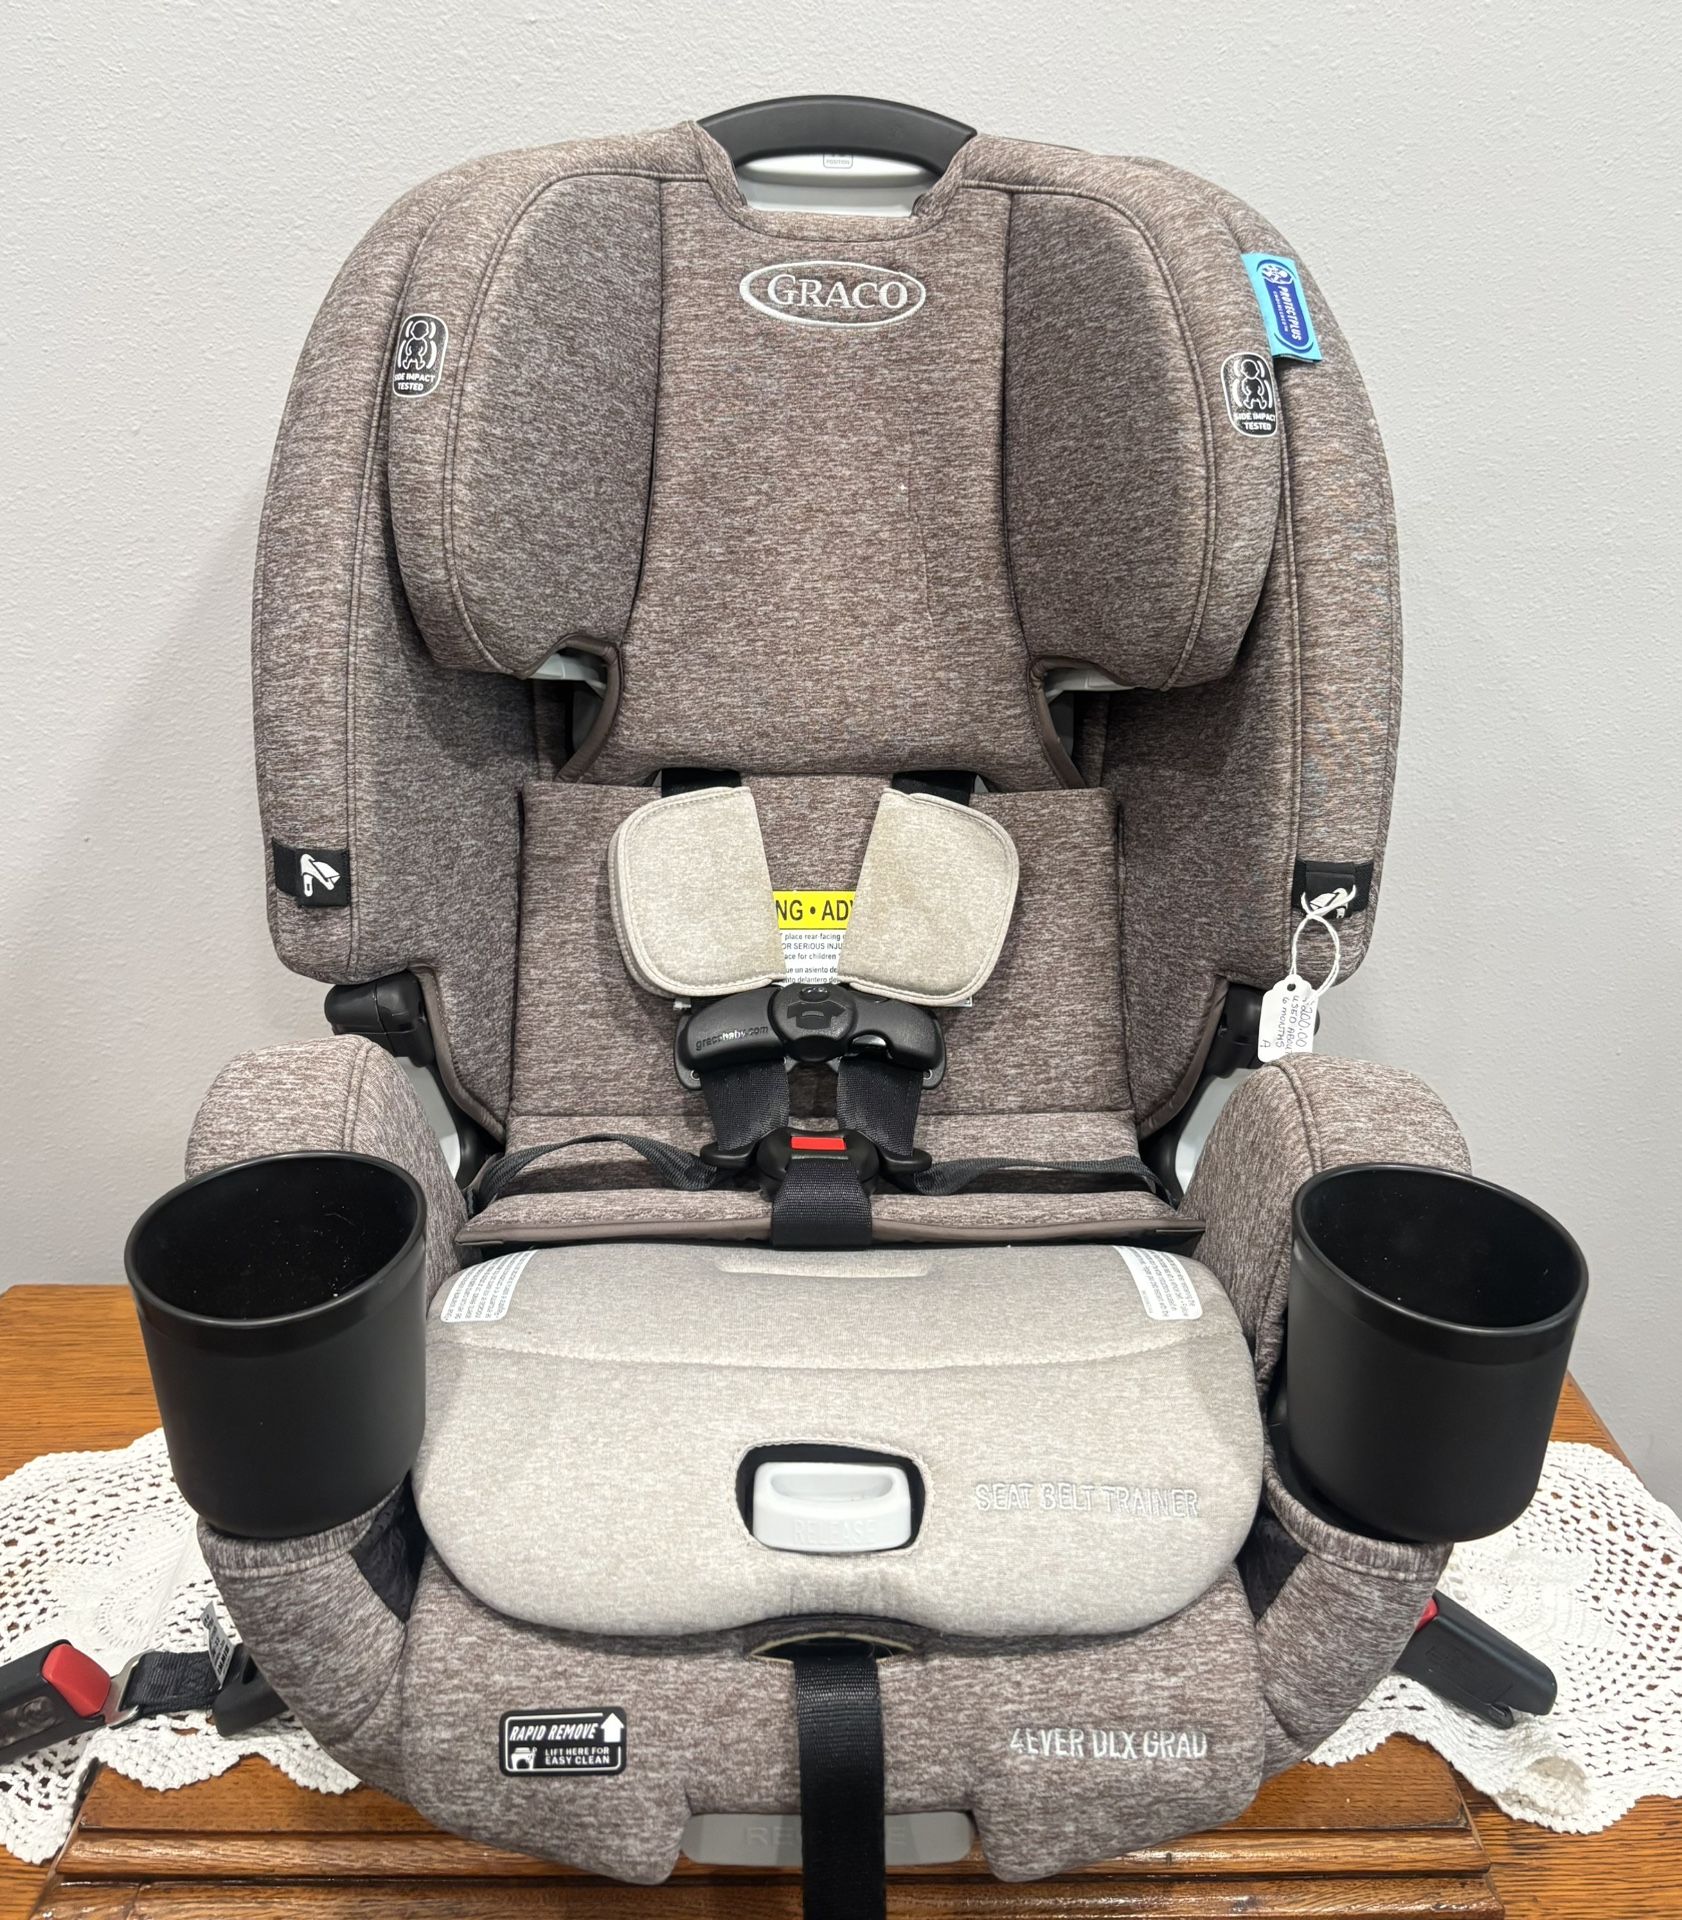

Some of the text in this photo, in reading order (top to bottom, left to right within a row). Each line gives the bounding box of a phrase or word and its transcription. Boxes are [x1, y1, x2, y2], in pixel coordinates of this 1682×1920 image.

[767, 273, 909, 309] GRACO
[406, 373, 436, 383] IMPACT
[397, 382, 424, 391] TESTED
[1233, 412, 1252, 420] SIDE
[1244, 421, 1272, 431] TESTED
[784, 932, 803, 941] place
[793, 942, 825, 950] SERIOUS
[797, 952, 807, 960] for
[808, 952, 837, 960] children
[804, 966, 829, 974] asiento
[975, 1482, 1200, 1518] SEAT BELT TRAINER
[793, 1518, 877, 1546] RELEASE
[509, 1722, 599, 1741] RAPID REMOVE
[1009, 1727, 1208, 1759] 4EVER DLX GRAD
[544, 1746, 610, 1756] LIFT HERE FOR
[544, 1755, 611, 1766] EASY CLEAN
